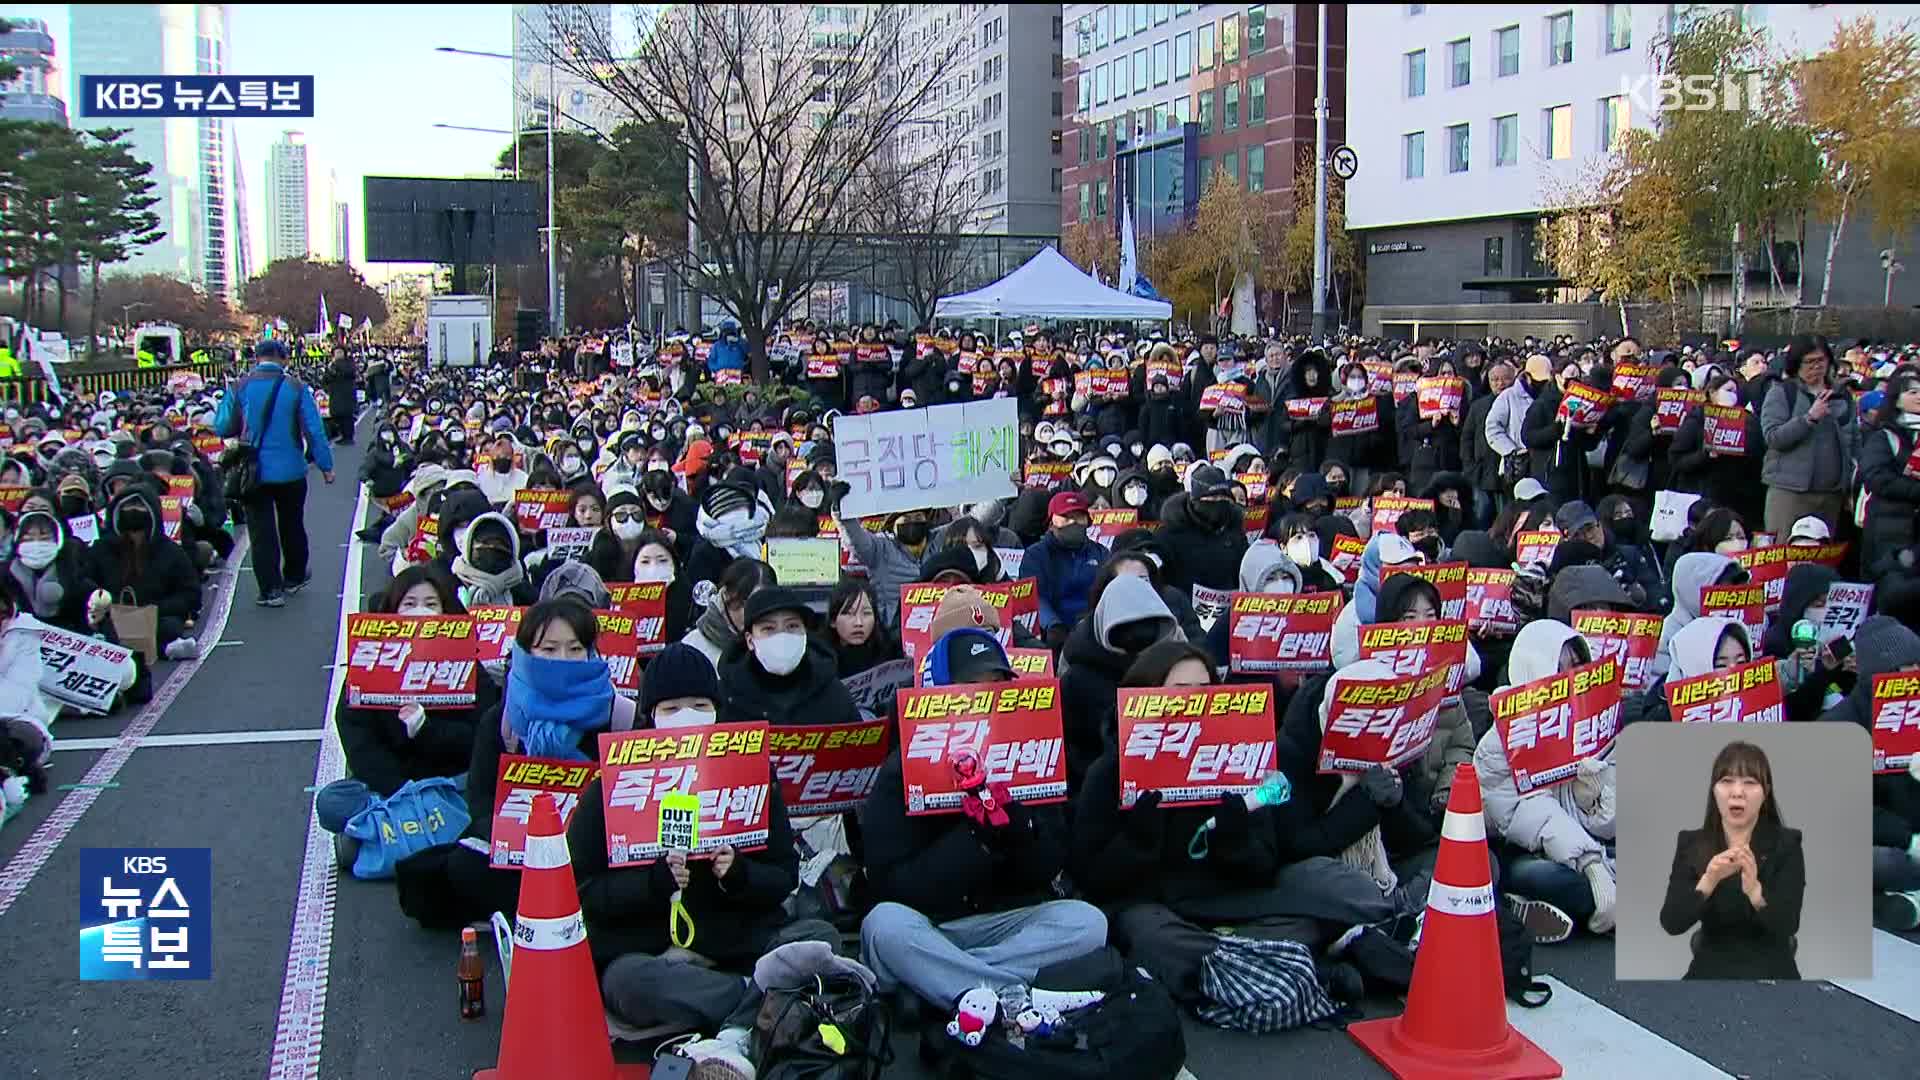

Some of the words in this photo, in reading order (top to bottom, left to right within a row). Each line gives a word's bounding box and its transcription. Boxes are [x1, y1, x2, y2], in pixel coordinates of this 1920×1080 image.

[842, 432, 944, 494] 국짐당
[1011, 582, 1033, 599] 석열
[1233, 596, 1290, 615] 내란수괴
[351, 617, 417, 639] 내란수괴
[419, 617, 473, 640] 윤석열
[1233, 615, 1288, 642] 즉각
[1362, 626, 1431, 649] 내란수괴
[1575, 616, 1632, 636] 내란수괴
[350, 640, 412, 673] 즉각
[1277, 631, 1331, 659] 탄핵!
[401, 658, 476, 692] 탄핵!
[1497, 677, 1570, 719] 내란수괴
[1573, 659, 1616, 695] 윤석열
[1672, 671, 1741, 707] 내란수괴
[1743, 661, 1774, 690] 윤석열
[904, 691, 995, 720] 내란수괴
[996, 686, 1056, 713] 윤석열
[1123, 693, 1208, 720] 내란수괴
[1209, 690, 1269, 718] 윤석열
[1338, 680, 1416, 705] 내란수괴
[769, 732, 824, 751] 란수괴
[824, 725, 885, 749] 윤석열
[1330, 706, 1406, 739] 즉각
[1507, 703, 1572, 751] 즉각
[606, 733, 704, 767] 내란수괴
[705, 728, 767, 757] 윤석열
[1124, 720, 1203, 761] 즉각
[503, 762, 590, 788] 내란수괴
[985, 737, 1063, 785] 탄핵!
[1186, 740, 1275, 782] 탄핵!
[800, 765, 881, 801] 탄핵!
[662, 808, 694, 822] OUT
[695, 783, 768, 832] 탄핵!
